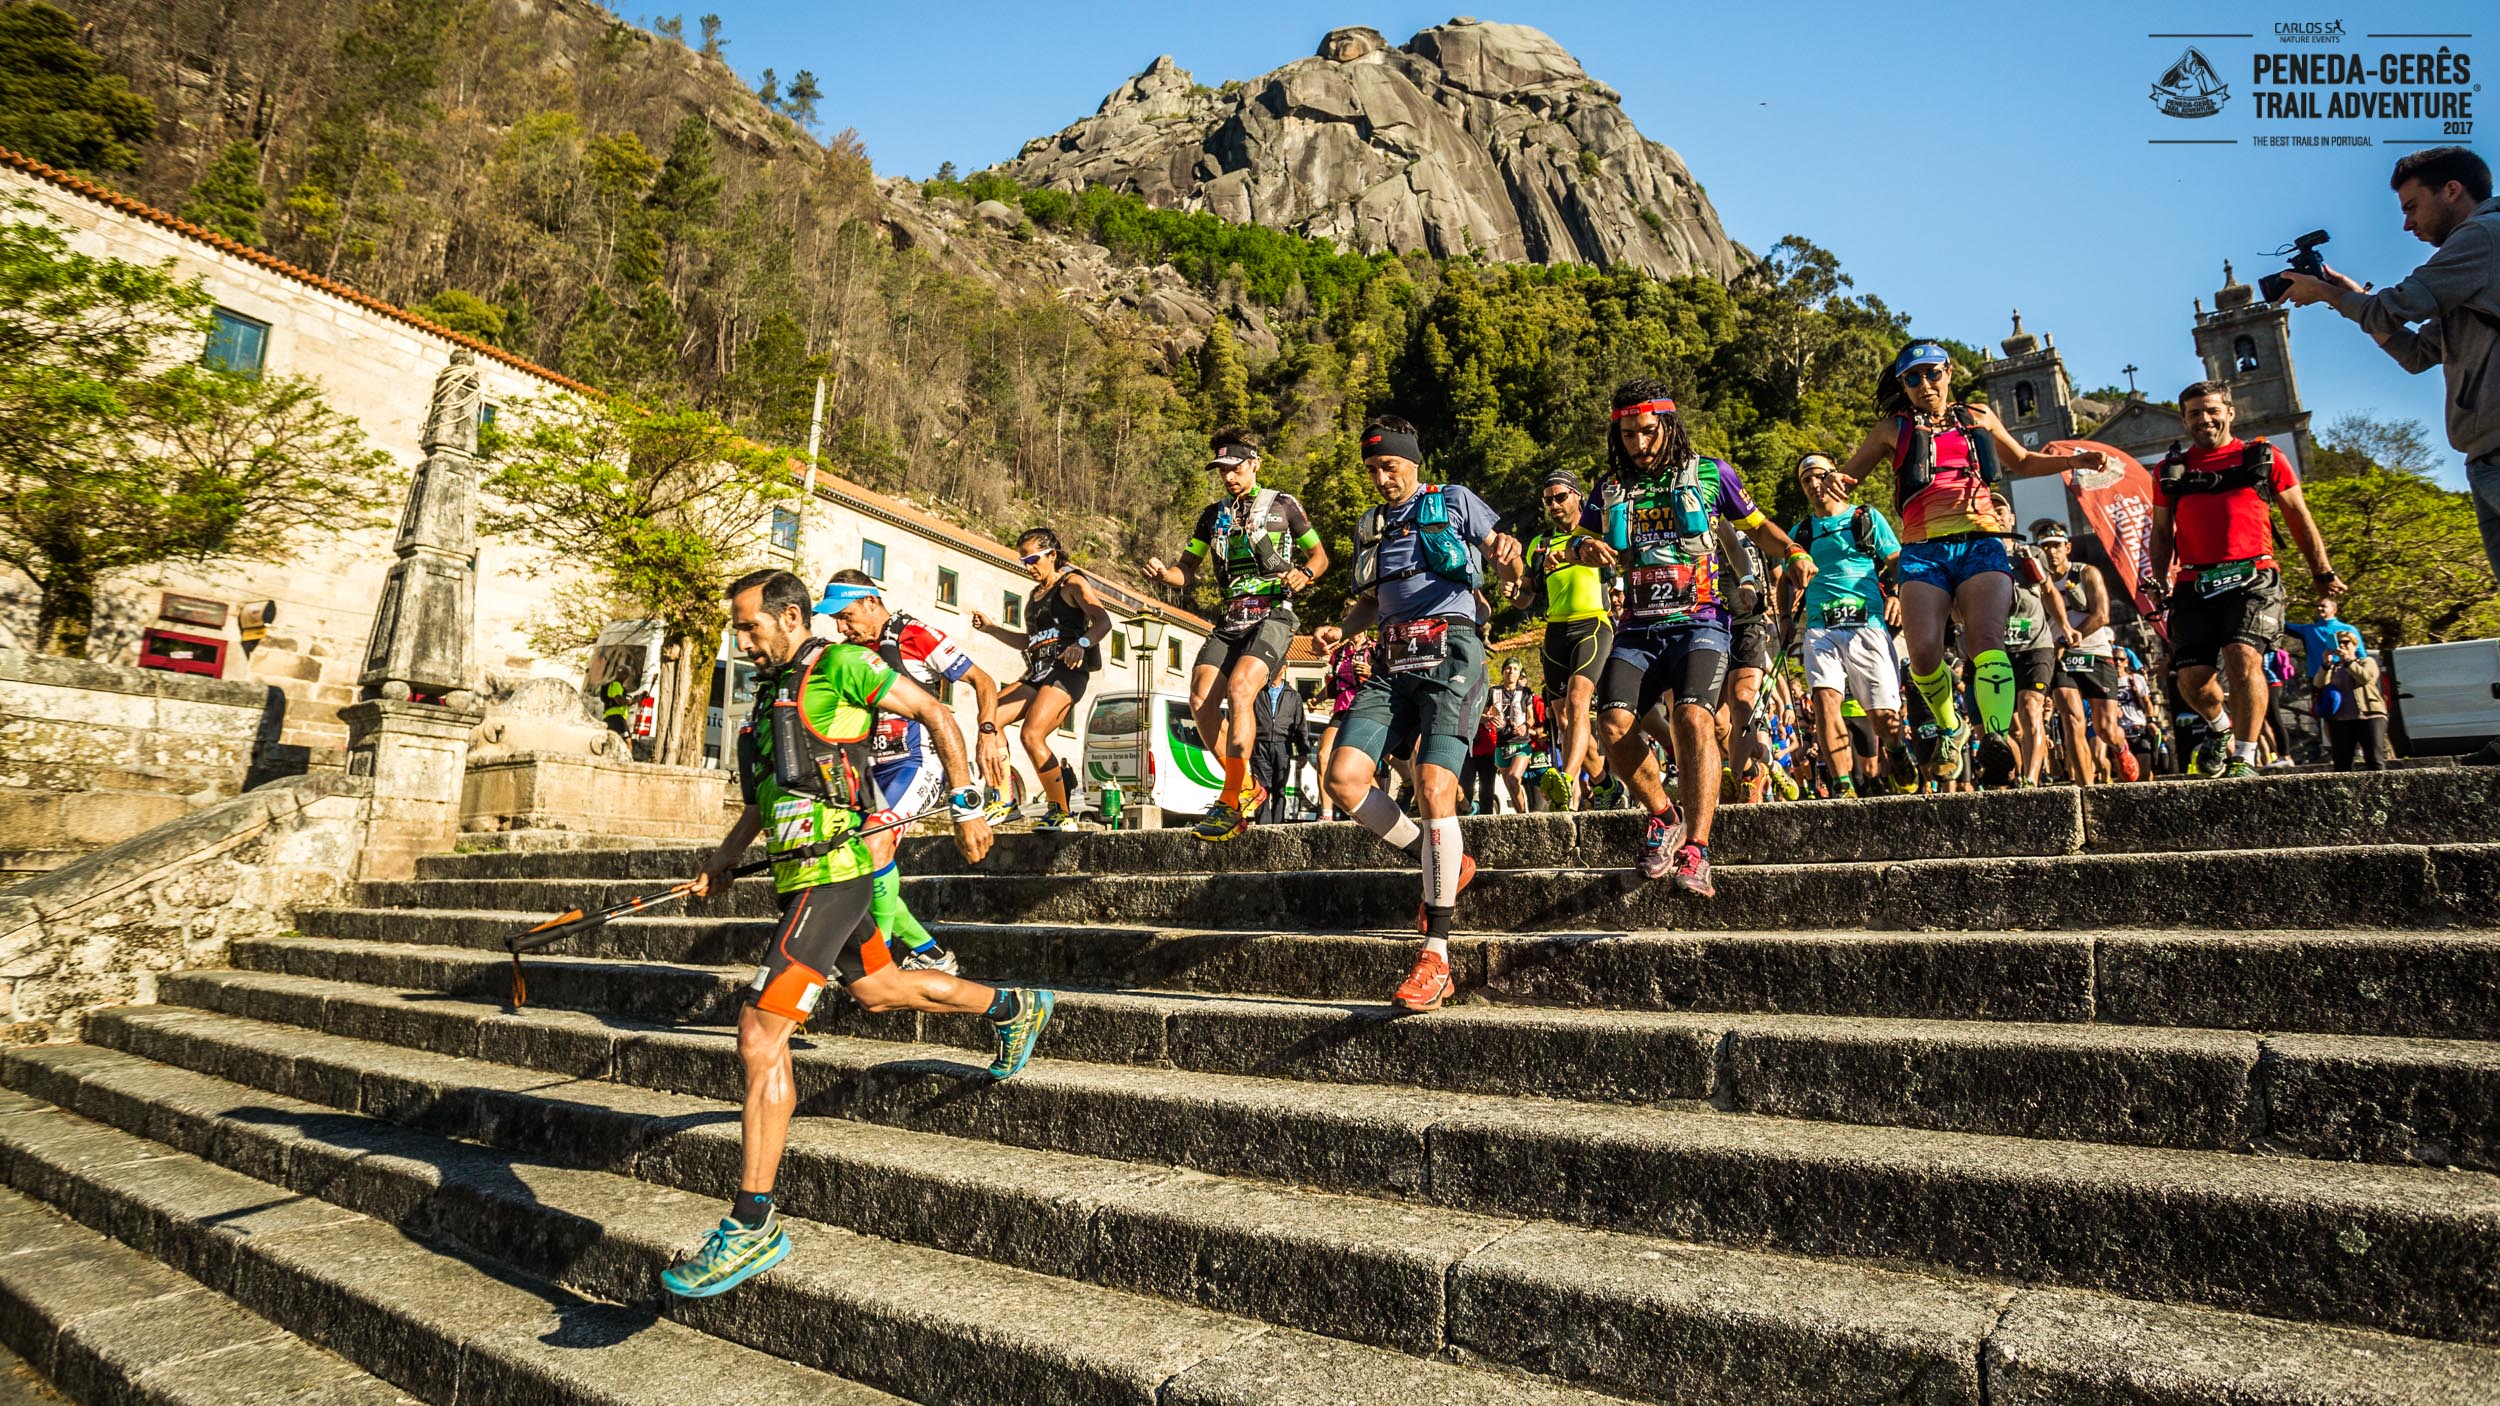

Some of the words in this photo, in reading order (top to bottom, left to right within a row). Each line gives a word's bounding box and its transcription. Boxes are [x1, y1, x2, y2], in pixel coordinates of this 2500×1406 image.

[1650, 582, 1673, 601] 22
[1833, 605, 1857, 619] 512
[1407, 637, 1418, 654] 4
[2066, 656, 2085, 665] 506
[1432, 850, 1442, 900] COMPRESSION
